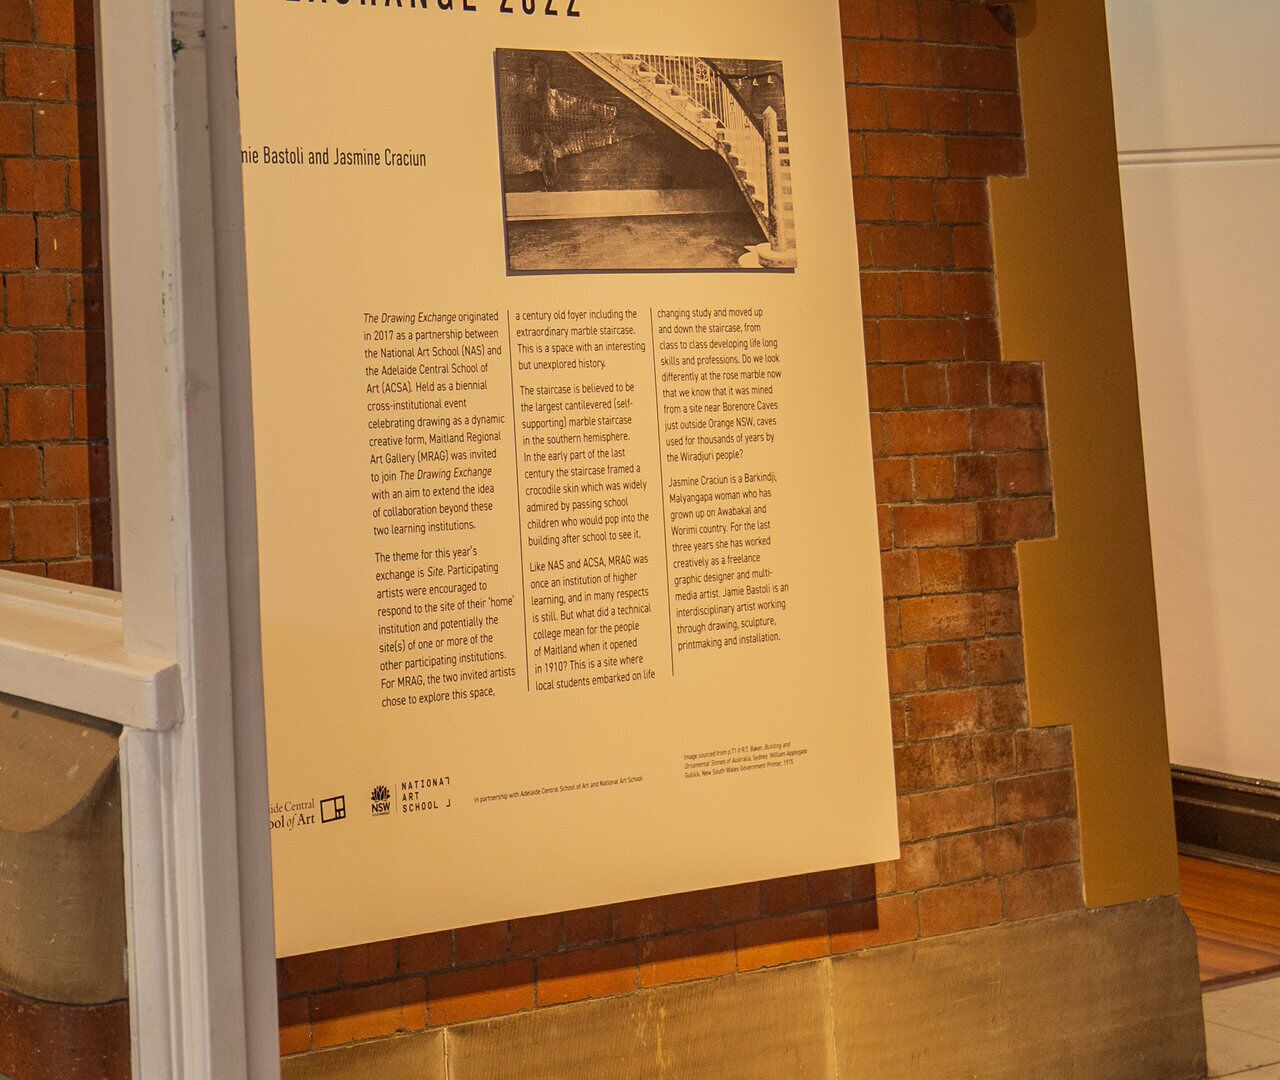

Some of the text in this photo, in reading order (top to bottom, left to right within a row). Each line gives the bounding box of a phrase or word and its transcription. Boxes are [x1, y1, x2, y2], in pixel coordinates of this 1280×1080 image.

[263, 146, 304, 164] Bastoli
[308, 148, 329, 165] and
[333, 148, 381, 166] Jasmine
[384, 148, 426, 167] Craciun
[364, 312, 499, 325] The Drawing Exchange originated
[516, 309, 637, 322] a century old foyer including the
[657, 308, 763, 320] changing study and moved up
[364, 329, 498, 342] in 2017 as a partnership between
[516, 327, 568, 338] extraordinary
[571, 326, 598, 336] marble
[365, 344, 501, 358] the National Art School (NAS) and
[517, 344, 534, 353] This
[536, 343, 543, 353] is
[545, 345, 549, 353] a
[551, 345, 574, 355] space
[576, 342, 592, 351] with
[606, 342, 645, 352] interesting
[661, 356, 680, 366] skills
[682, 356, 695, 365] and
[742, 354, 751, 363] Do
[765, 354, 780, 363] look
[366, 363, 488, 376] the Adelaide Central School of
[367, 384, 379, 393] Art
[416, 381, 435, 392] Held
[437, 383, 446, 391] as
[448, 383, 453, 391] a
[456, 380, 487, 391] biennial
[367, 399, 467, 411] cross-institutional event
[368, 414, 505, 430] celebrating drawing as a dynamic
[369, 436, 403, 447] creative
[429, 433, 464, 444] Maitland
[466, 431, 501, 444] Regional
[370, 449, 497, 465] Art Gallery (MRAG) was invited
[371, 467, 492, 484] to join The Drawing Exchange
[669, 476, 699, 487] Jasmine
[701, 475, 728, 485] Craciun
[730, 474, 736, 483] is
[714, 492, 740, 500] woman
[742, 489, 757, 498] who
[759, 488, 771, 497] has
[530, 562, 546, 572] Like
[548, 559, 564, 570] NAS
[567, 558, 581, 569] and
[608, 554, 631, 565] MRAG
[381, 678, 395, 688] For
[427, 674, 440, 684] the
[443, 674, 458, 683] two
[460, 669, 488, 681] invited
[490, 667, 516, 678] artists
[536, 669, 655, 691] local students embarked on life
[402, 792, 420, 802] ART
[284, 798, 315, 812] Central
[371, 802, 391, 814] NSW
[402, 801, 438, 813] SCHOOL
[297, 812, 316, 826] Art
